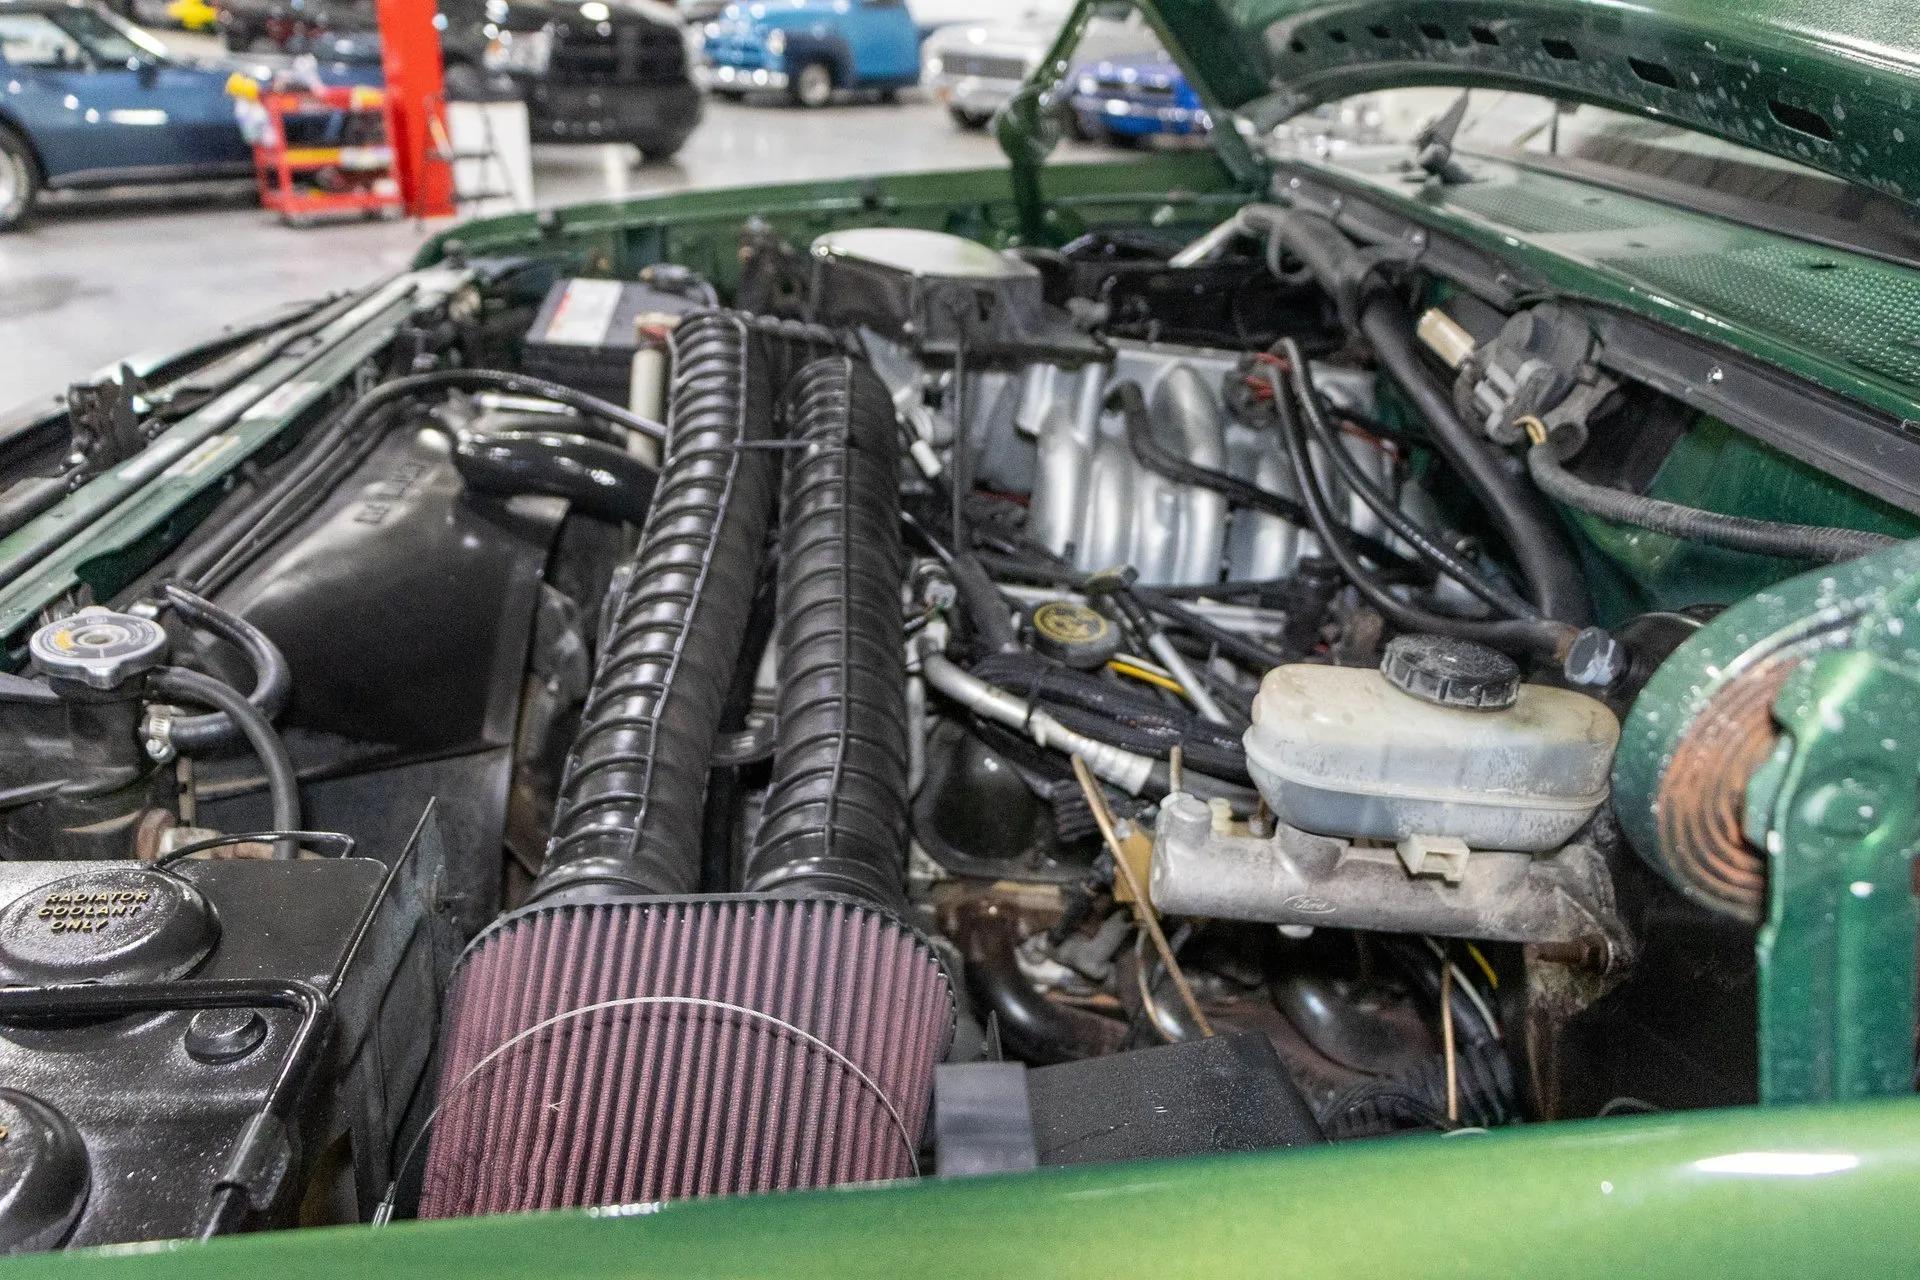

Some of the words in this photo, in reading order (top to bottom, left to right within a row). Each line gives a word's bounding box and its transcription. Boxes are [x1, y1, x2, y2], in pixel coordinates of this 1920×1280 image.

[45, 891, 150, 906] RADIATOR
[38, 905, 141, 920] COOLANT
[51, 919, 109, 934] ONLY
